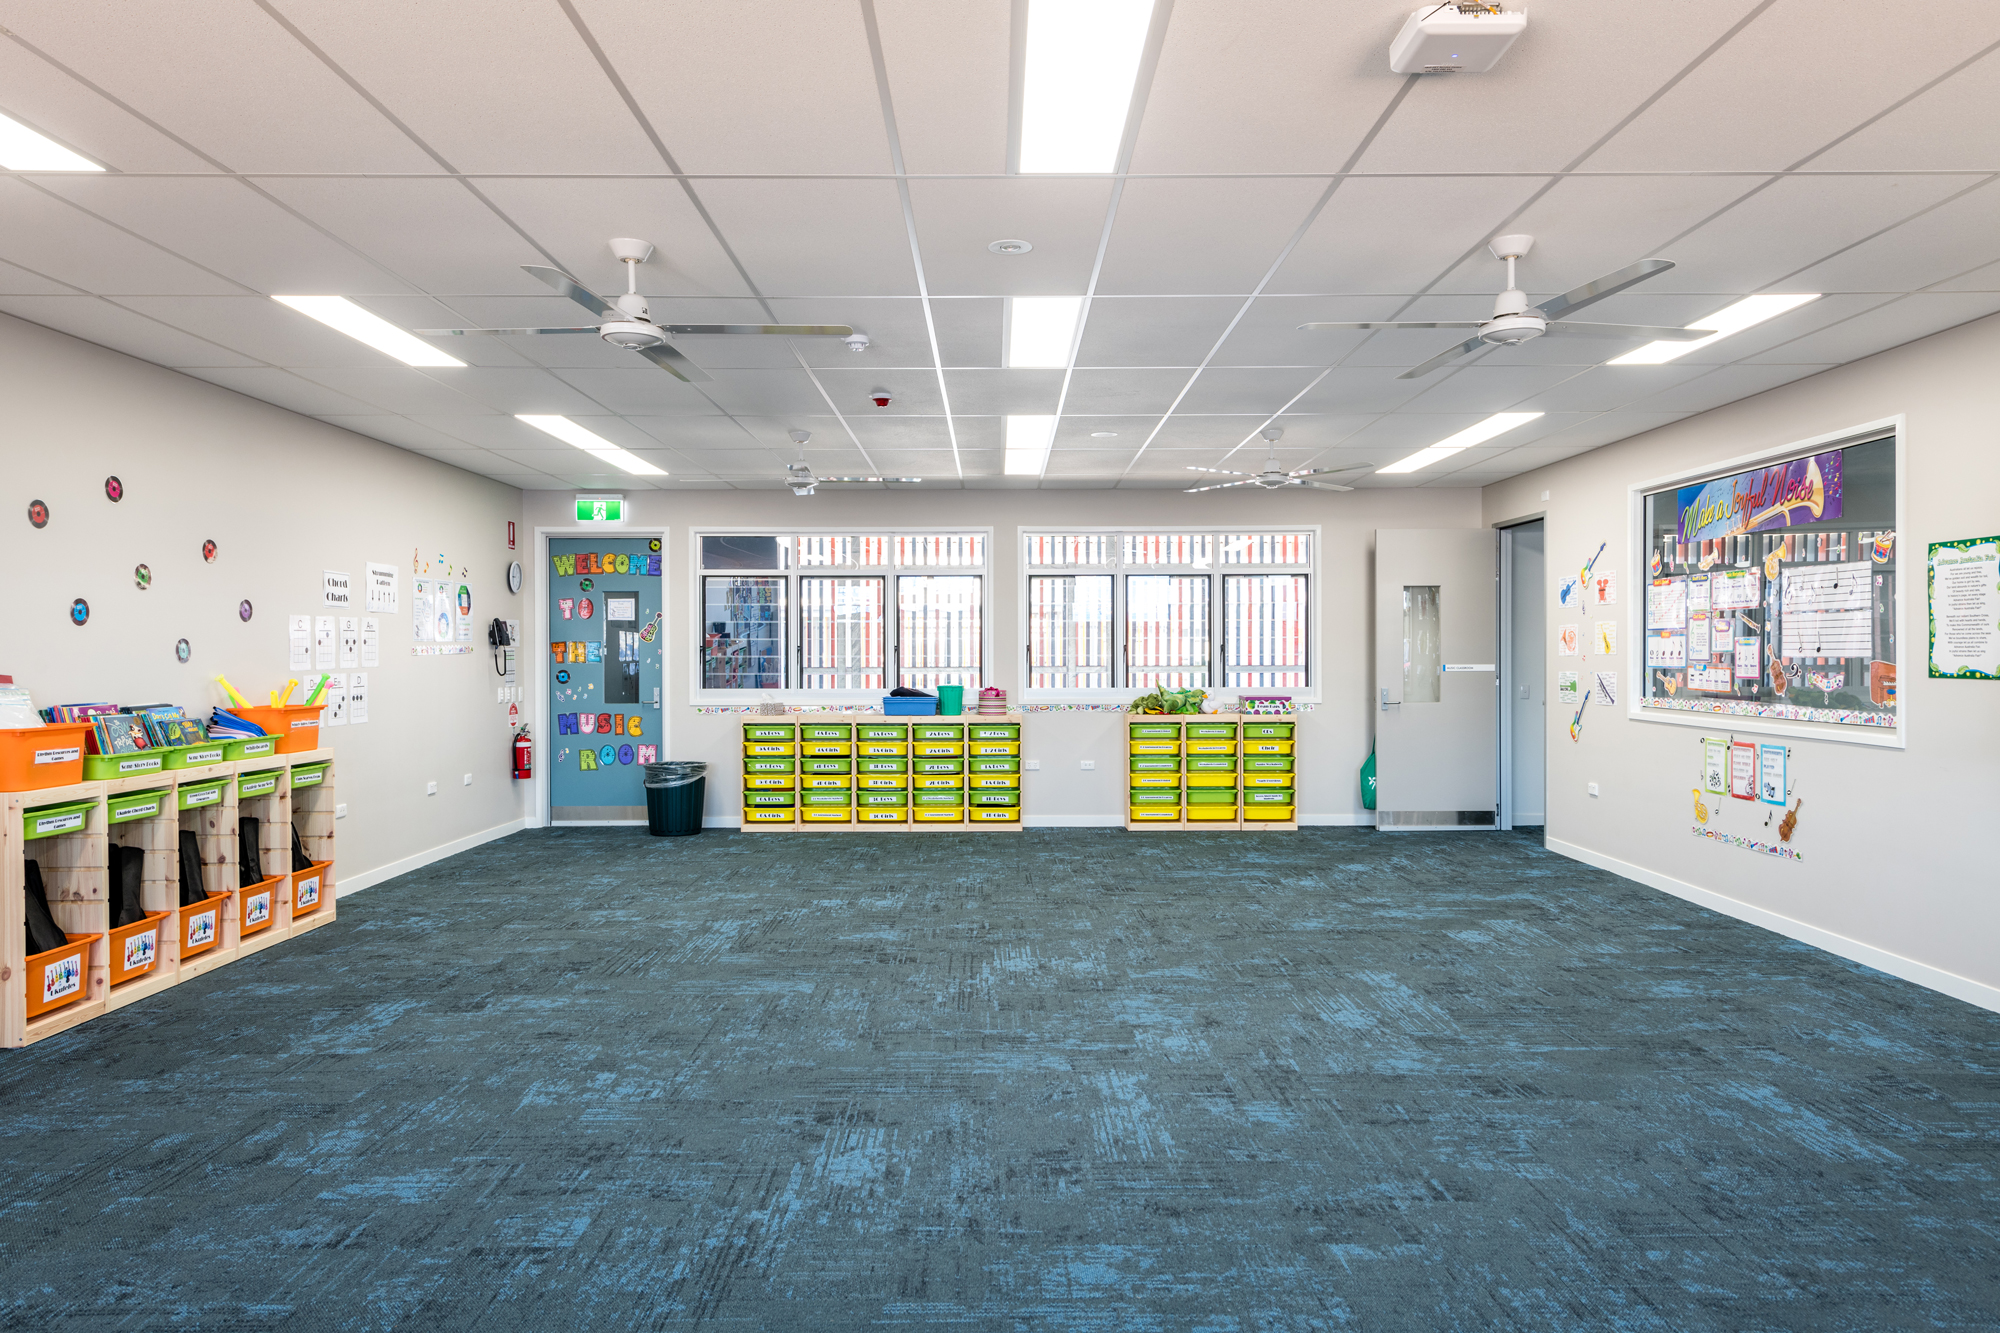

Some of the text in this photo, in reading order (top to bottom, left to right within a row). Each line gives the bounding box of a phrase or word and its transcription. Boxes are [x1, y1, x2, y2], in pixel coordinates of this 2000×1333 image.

[1681, 464, 1814, 543] Make a Joyful Noise
[551, 553, 662, 577] WELCOME
[327, 577, 348, 589] Chord
[326, 592, 349, 603] Charts
[558, 597, 594, 620] TO
[297, 619, 303, 629] C
[323, 620, 327, 628] F
[346, 620, 351, 629] G
[551, 640, 602, 664] THE
[357, 675, 362, 685] D
[111, 721, 129, 737] COW
[557, 712, 644, 737] MUSIC
[579, 743, 658, 771] ROOM
